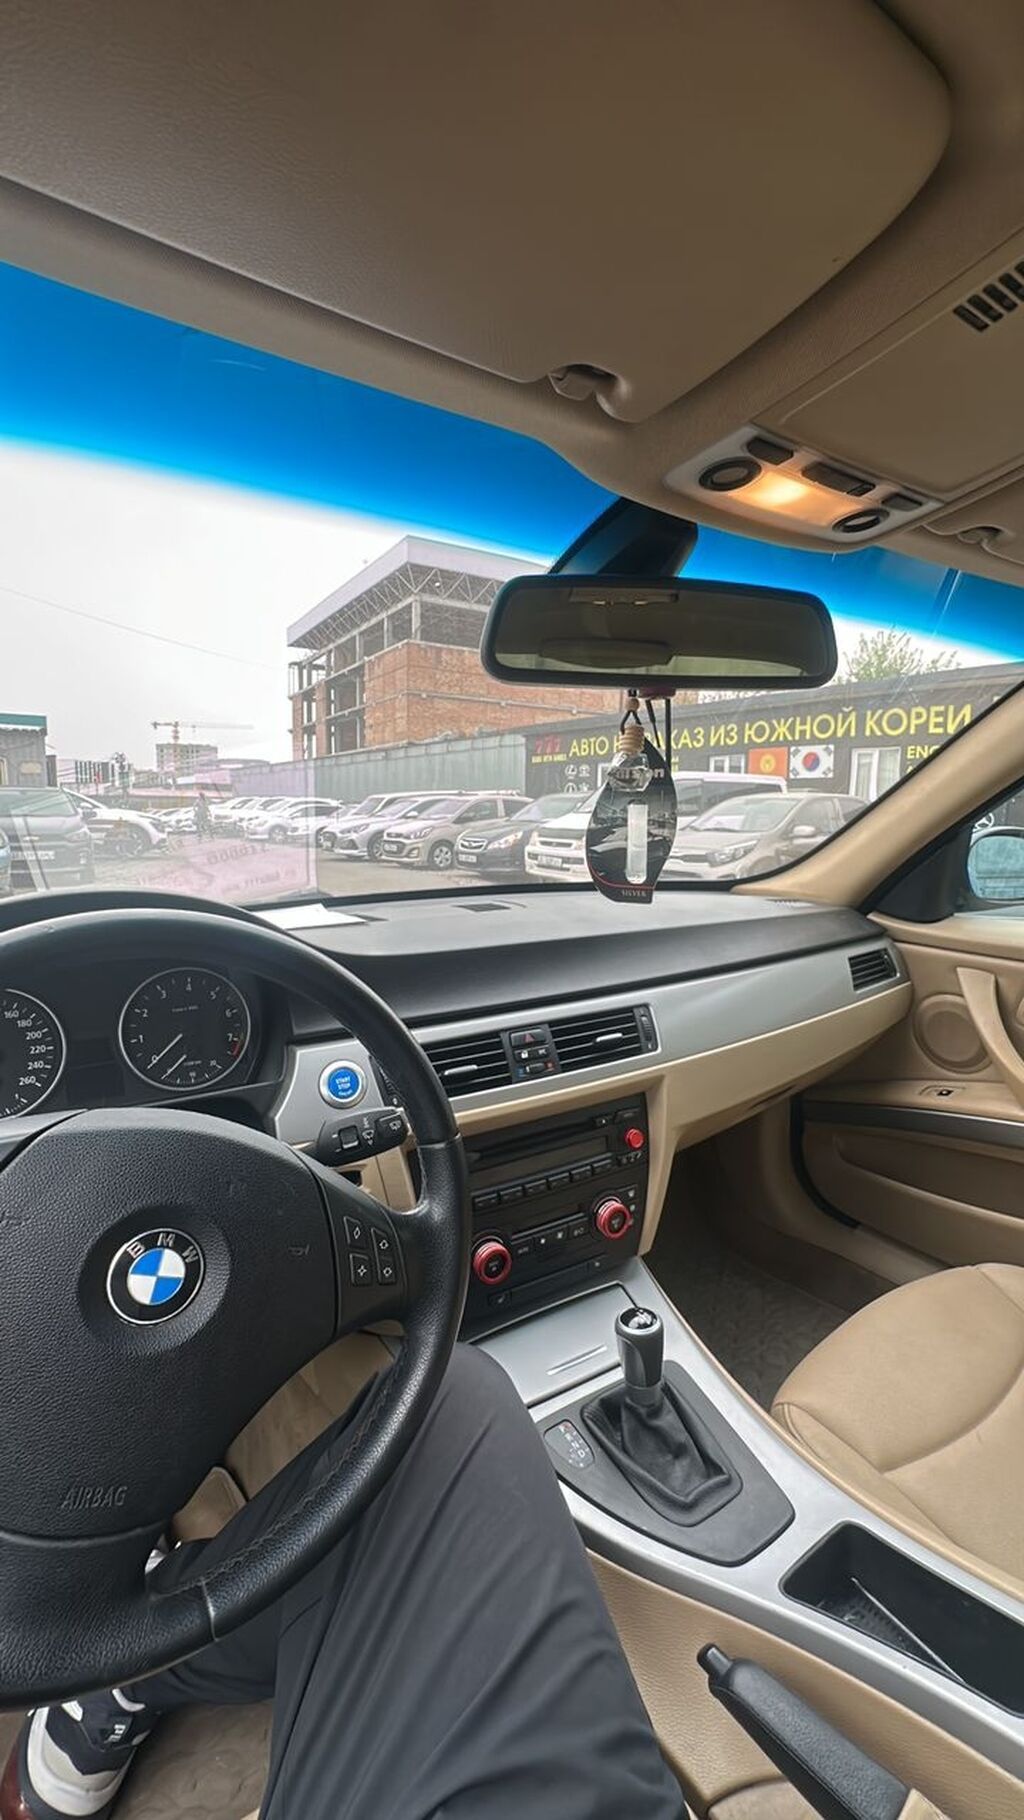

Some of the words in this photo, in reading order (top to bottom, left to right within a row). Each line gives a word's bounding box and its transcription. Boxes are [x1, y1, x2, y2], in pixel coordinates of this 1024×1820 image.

[568, 736, 609, 757] АВТО
[709, 724, 738, 747] ИЗ
[744, 707, 856, 744] ЮЖНОЙ
[865, 704, 972, 736] КОРЕИ
[4, 1010, 19, 1019] 160
[17, 1019, 32, 1028] 180
[26, 1031, 42, 1040] 200
[30, 1045, 46, 1054] 220
[28, 1061, 44, 1070] 240
[19, 1076, 36, 1085] 260
[126, 1232, 199, 1263] BMW
[61, 1486, 127, 1510] AIRBAG
